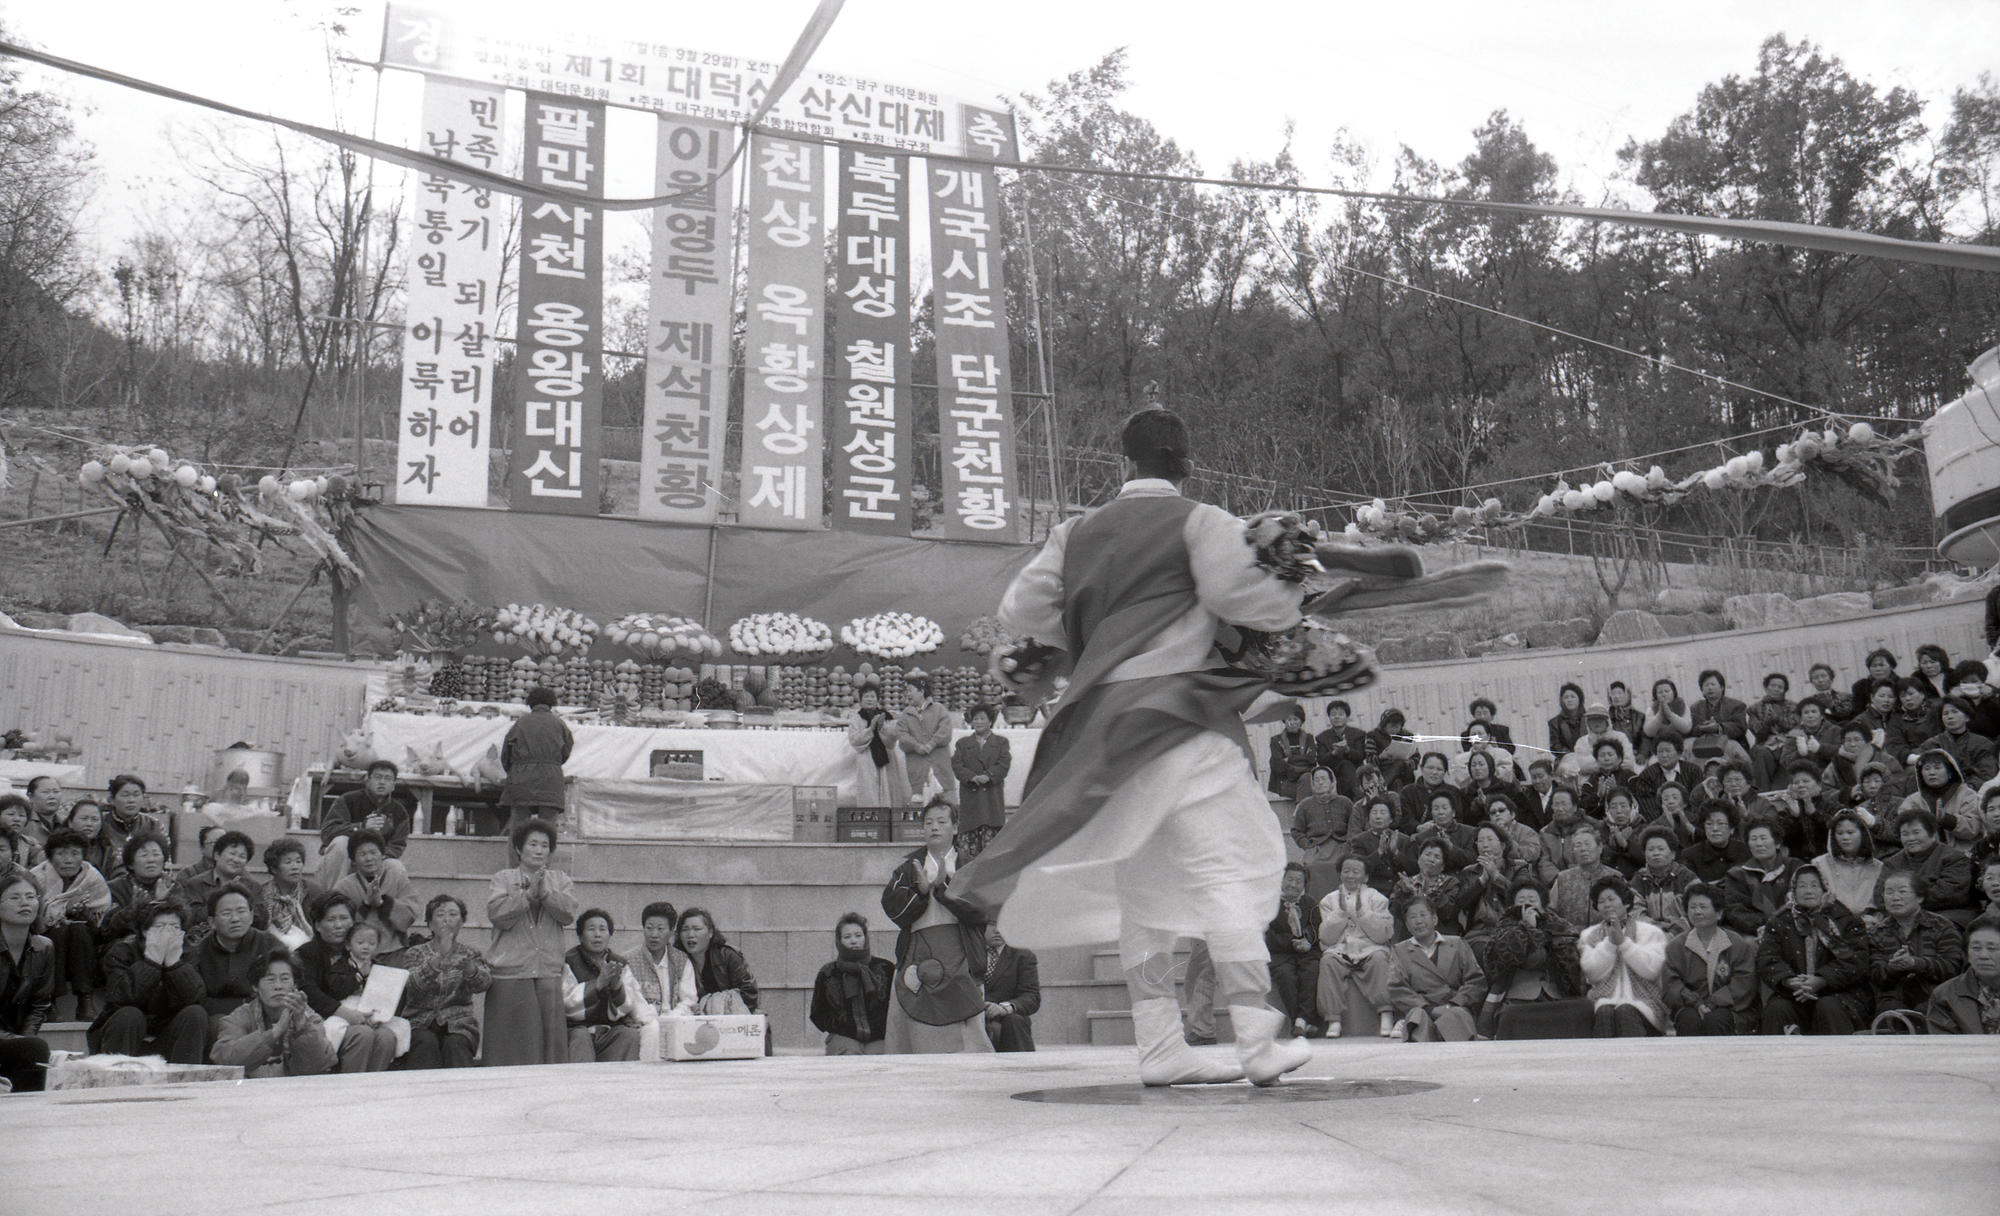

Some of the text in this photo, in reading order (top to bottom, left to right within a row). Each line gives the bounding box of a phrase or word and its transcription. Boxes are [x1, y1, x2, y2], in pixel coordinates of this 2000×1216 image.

[397, 16, 443, 64] 경
[541, 79, 610, 101] 대덕문화원
[564, 53, 646, 87] 제1회
[799, 86, 945, 142] 산신대제
[746, 60, 770, 75] 오전
[857, 79, 878, 92] 남구
[884, 84, 938, 106] 대덕문화원
[967, 112, 1008, 158] 축
[403, 129, 460, 494] 남북통일 이룩하자
[449, 97, 499, 449] 민족정기 되살리어
[523, 104, 594, 498] 팔만사천 용왕대신
[654, 126, 720, 510] 이월영두 제석천황
[748, 142, 818, 520] 천상 옥황상제
[842, 152, 901, 521] 북두대성 칠원성군
[934, 168, 1010, 530] 개국시조 단군천황
